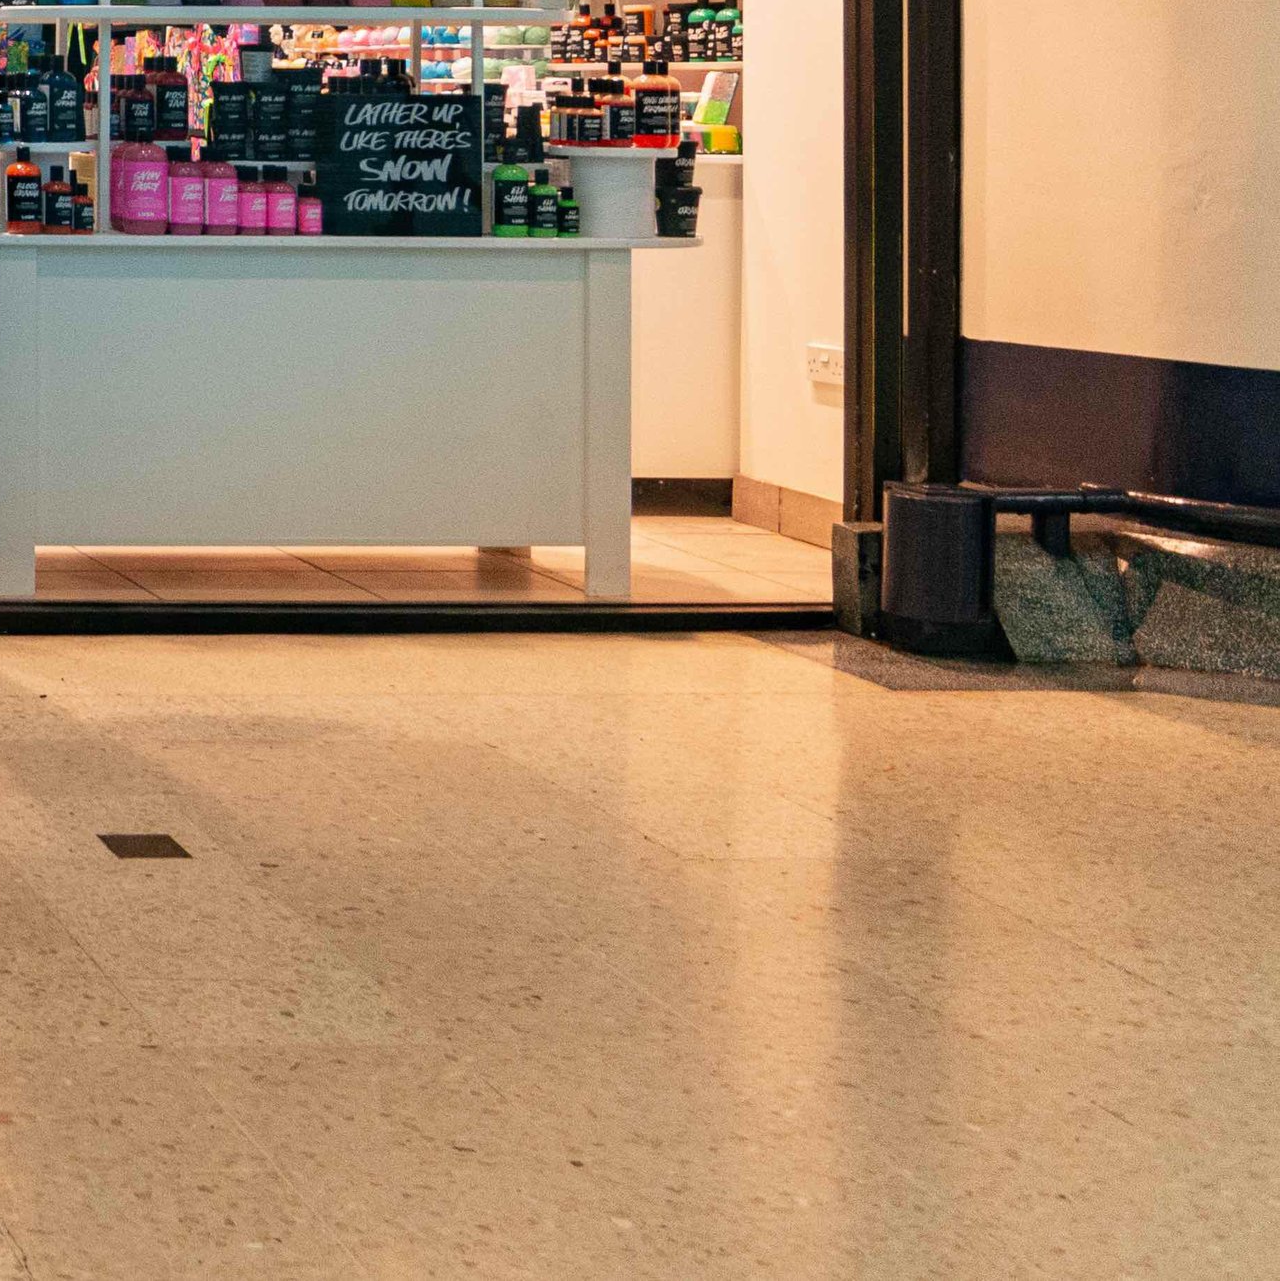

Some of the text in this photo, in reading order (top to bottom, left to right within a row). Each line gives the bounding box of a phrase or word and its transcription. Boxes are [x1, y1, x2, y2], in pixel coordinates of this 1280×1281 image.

[344, 102, 429, 126] LATHER
[340, 130, 391, 151] LIKE
[359, 153, 453, 182] SNOW
